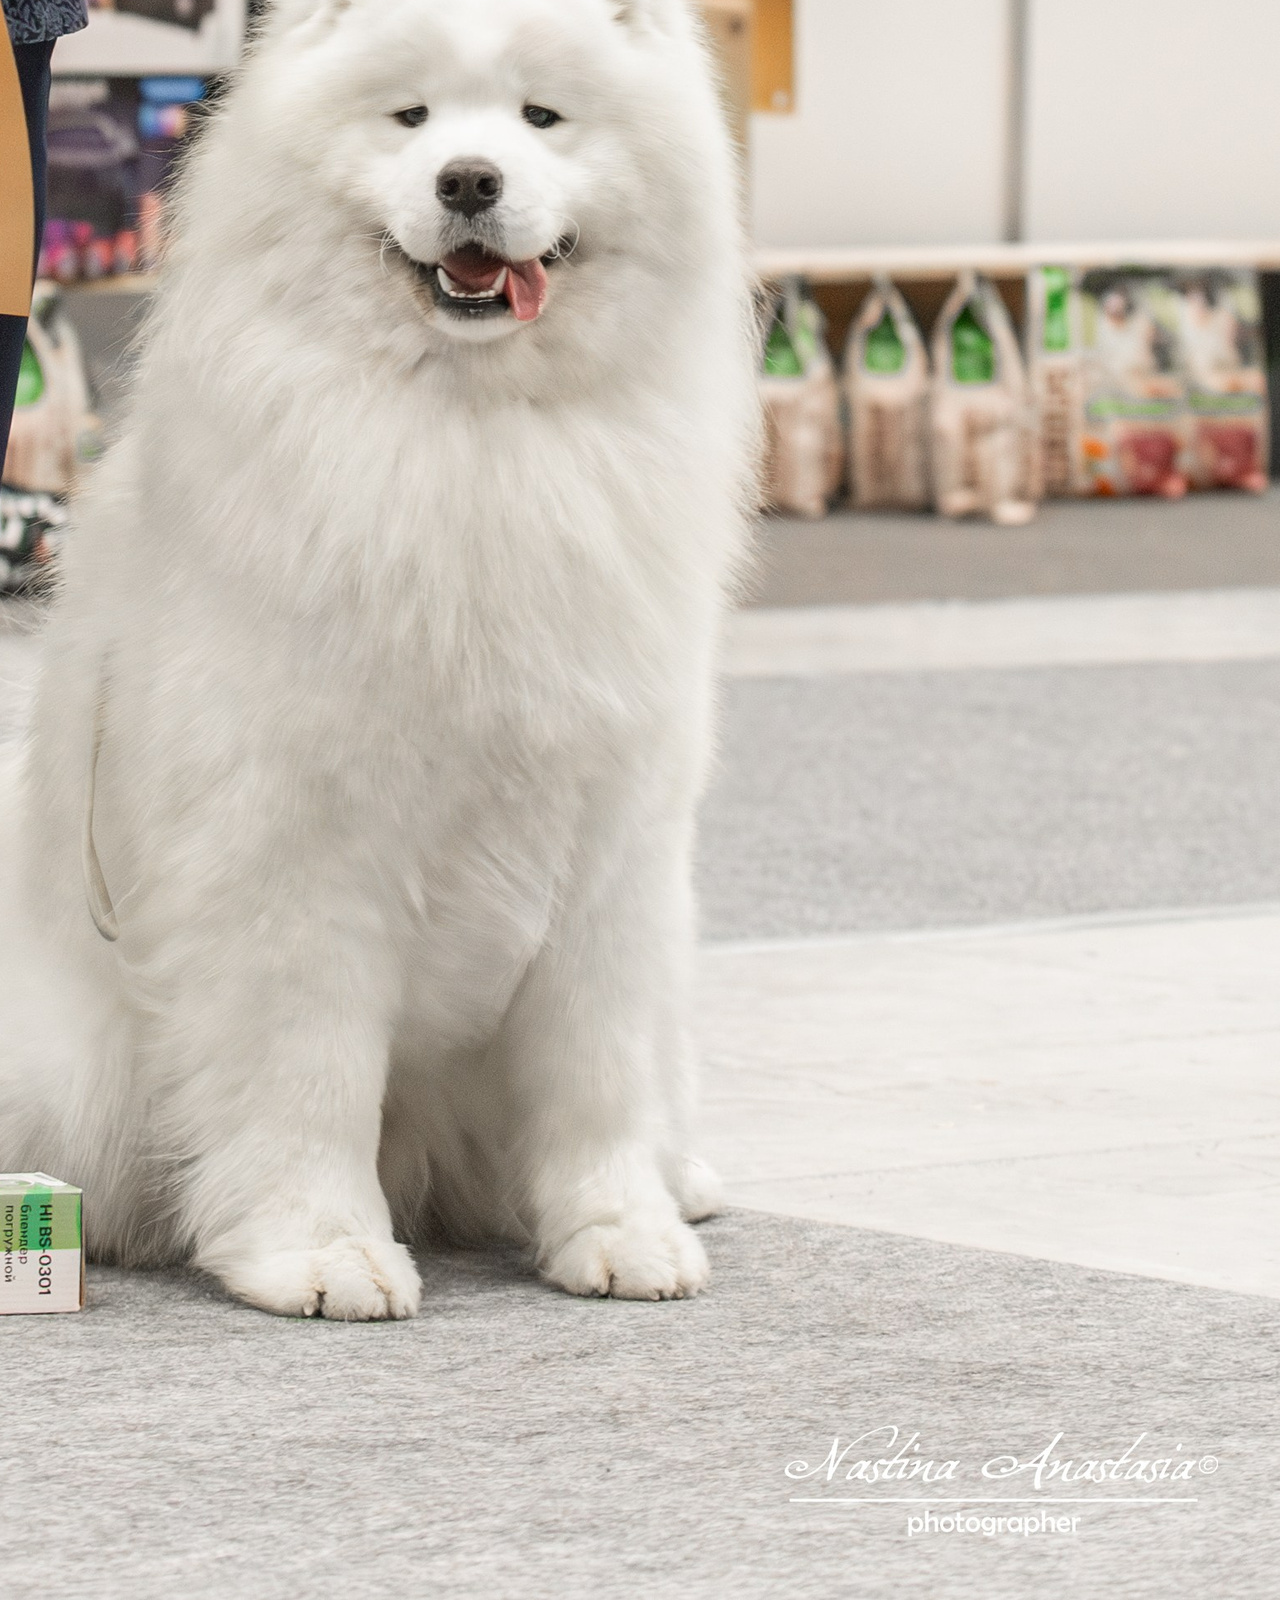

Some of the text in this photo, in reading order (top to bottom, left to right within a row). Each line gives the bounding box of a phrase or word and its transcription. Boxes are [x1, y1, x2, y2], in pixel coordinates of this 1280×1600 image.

[3, 1205, 16, 1283] погружной
[18, 1204, 31, 1265] блендер
[39, 1204, 53, 1296] HI BS-0301
